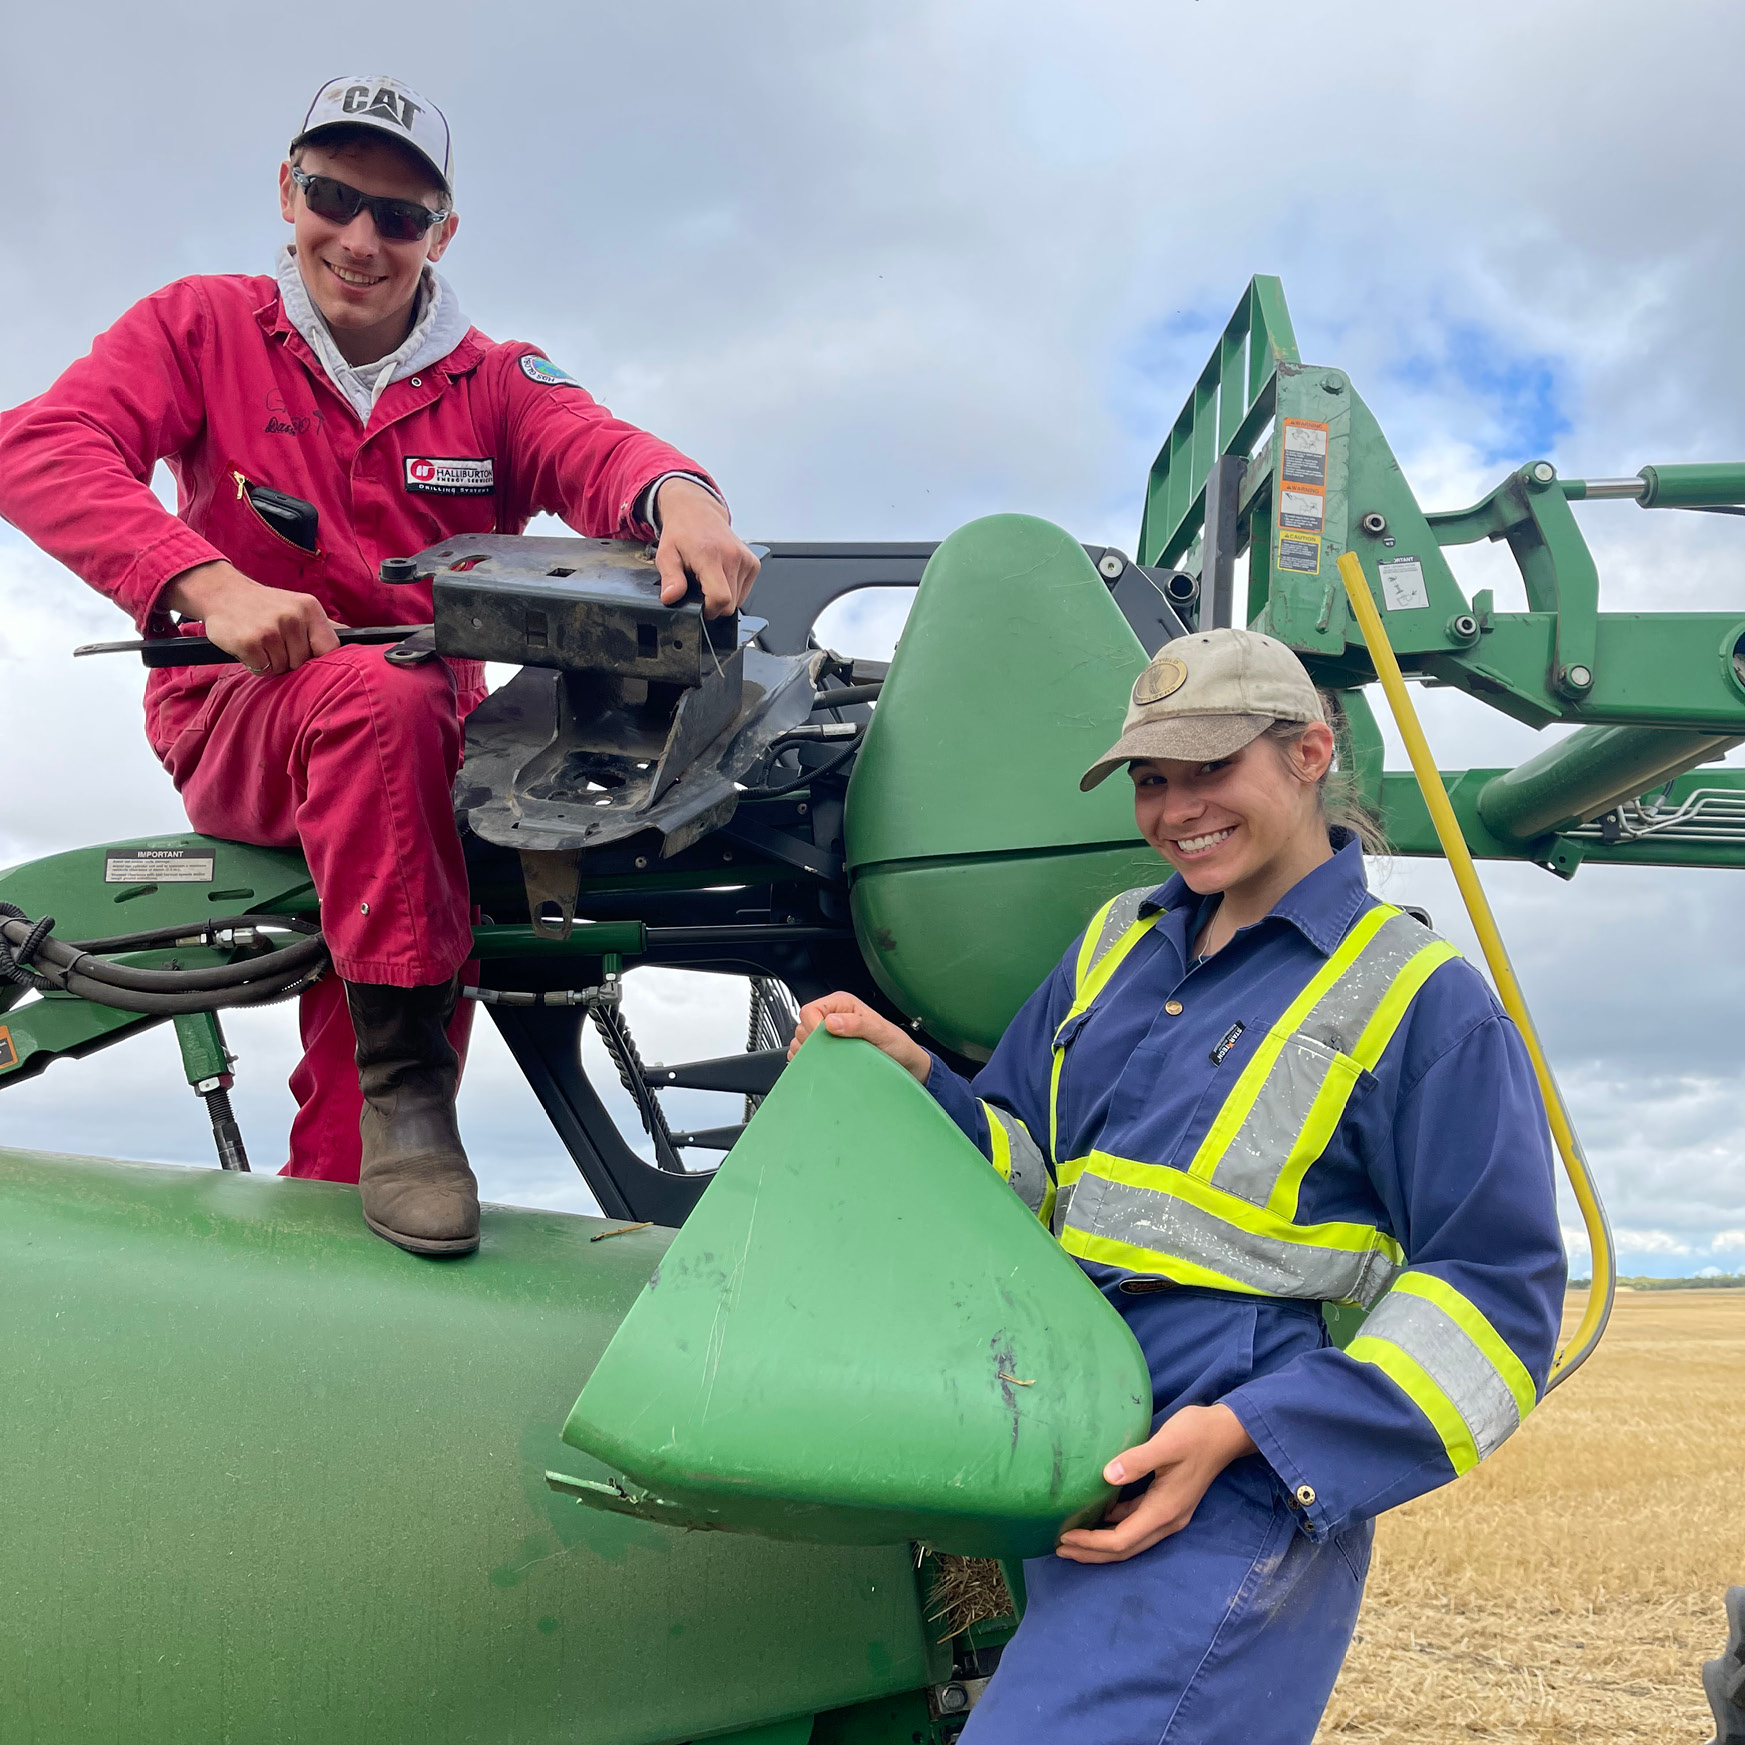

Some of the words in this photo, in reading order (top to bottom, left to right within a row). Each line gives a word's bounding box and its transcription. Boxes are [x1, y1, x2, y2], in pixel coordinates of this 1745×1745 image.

[342, 86, 422, 132] CAT
[436, 469, 493, 478] HALLIBURTON
[418, 484, 456, 493] DRILLING
[1292, 486, 1320, 494] WARNING
[1290, 533, 1316, 542] CAUTION
